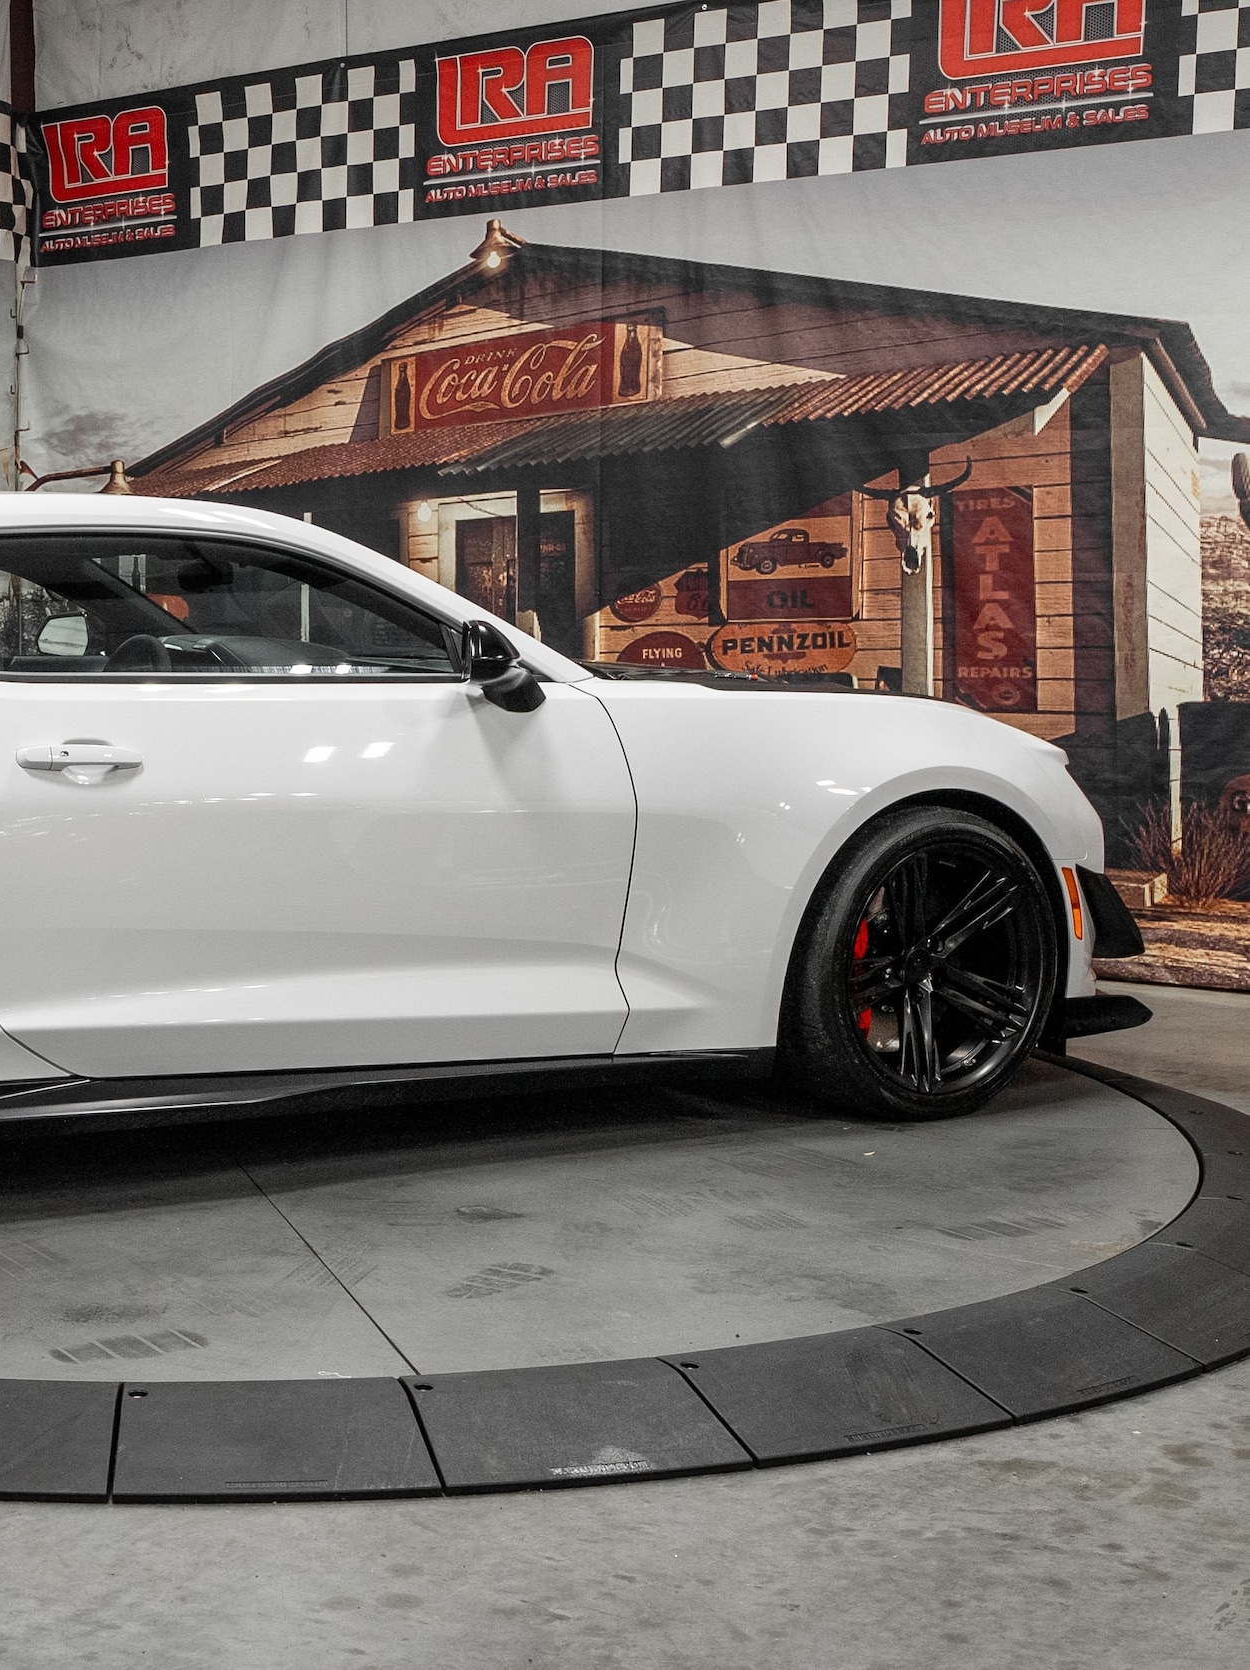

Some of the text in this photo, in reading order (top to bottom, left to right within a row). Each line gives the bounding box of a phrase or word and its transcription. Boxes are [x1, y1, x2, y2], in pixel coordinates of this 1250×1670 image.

[924, 63, 1152, 114] ENTERPRISES
[920, 104, 1149, 145] AUTO MUSEUM & SALES
[426, 134, 599, 176] ENTERPRISES
[425, 169, 597, 203] AUTO MUSEUM & SALES
[42, 193, 176, 228] ENTERPRISES
[40, 237, 74, 253] AUTO
[75, 231, 125, 249] MUSEUM
[135, 224, 176, 240] SALES
[464, 347, 516, 365] DRINK
[955, 497, 1015, 511] TIRES
[766, 589, 815, 609] OIL
[971, 516, 1014, 660] ATLAS
[642, 647, 682, 660] FLYING
[721, 630, 851, 655] PENNZOIL
[958, 666, 1033, 679] REPAIRS
